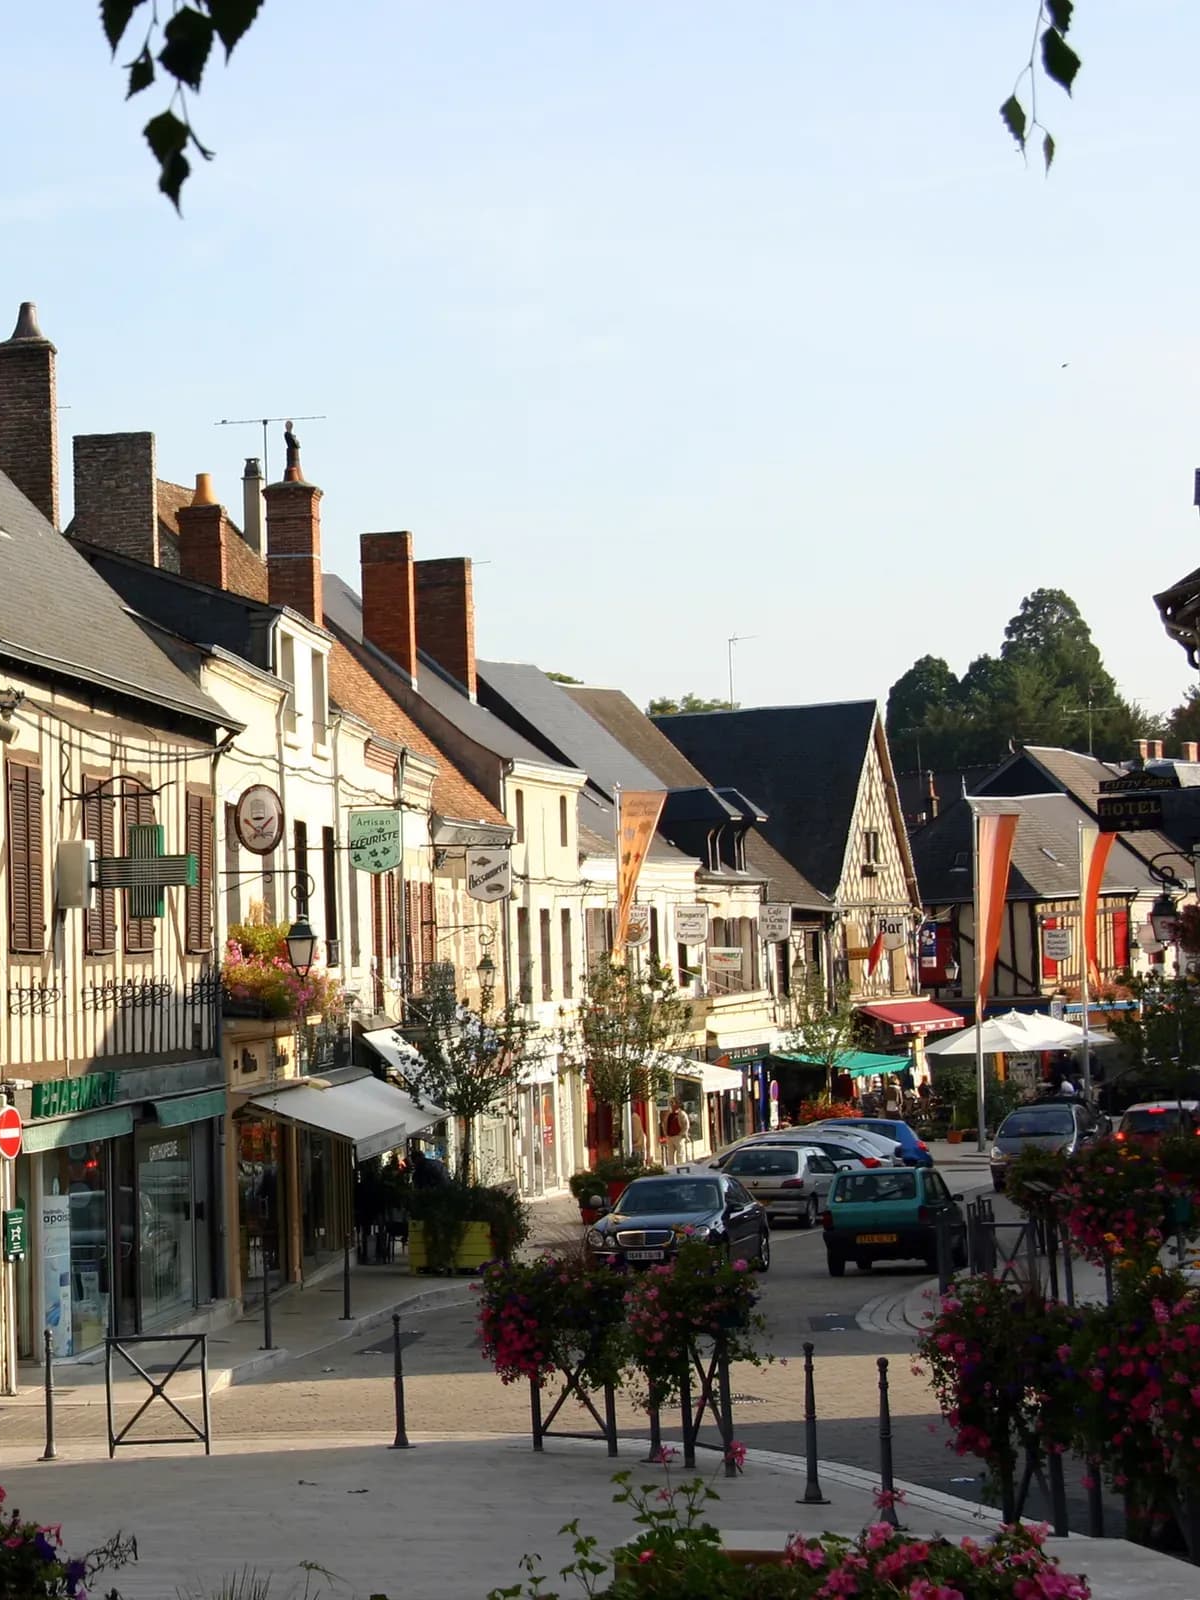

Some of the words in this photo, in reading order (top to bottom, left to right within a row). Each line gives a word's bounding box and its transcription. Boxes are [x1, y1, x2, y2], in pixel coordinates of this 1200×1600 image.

[1099, 801, 1161, 817] HOTEL
[356, 817, 391, 827] Artisan
[879, 918, 903, 934] Bar
